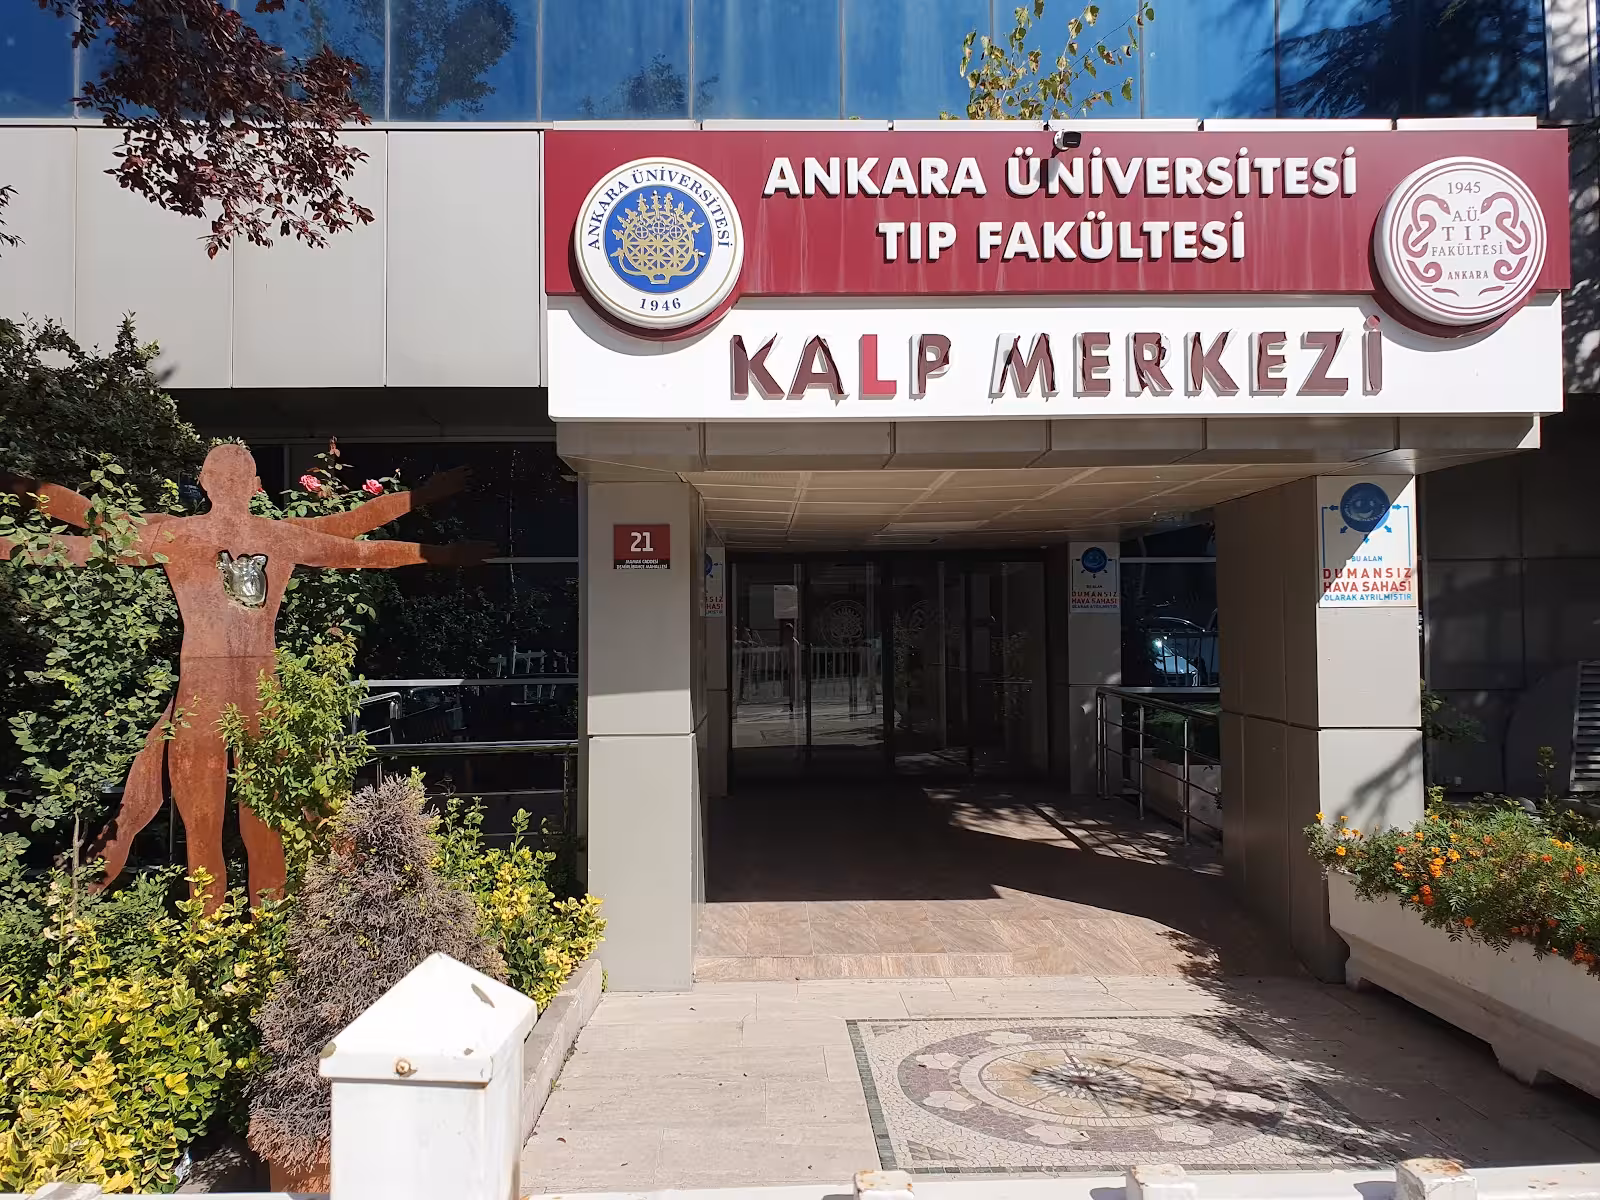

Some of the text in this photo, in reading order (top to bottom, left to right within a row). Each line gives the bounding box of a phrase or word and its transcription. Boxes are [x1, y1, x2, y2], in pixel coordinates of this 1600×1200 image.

[764, 146, 1357, 196] ANKARA ÜNİVERSİTESİ
[1447, 181, 1481, 195] 1945
[588, 166, 733, 250] ANKARA ÜNİVERSİTESİ
[877, 210, 1245, 261] TIP FAKÜLTESİ
[1441, 225, 1491, 241] TIP
[1431, 242, 1504, 257] FAKÜLTESİ
[1447, 270, 1489, 280] ANKARA
[640, 297, 681, 311] 1946
[730, 315, 1383, 402] KALP MERKEZİ
[630, 531, 654, 552] 21
[1323, 567, 1412, 579] DUMANSIZ
[1323, 580, 1412, 593] HAVA SAHASI
[1324, 594, 1358, 602] OLARAK
